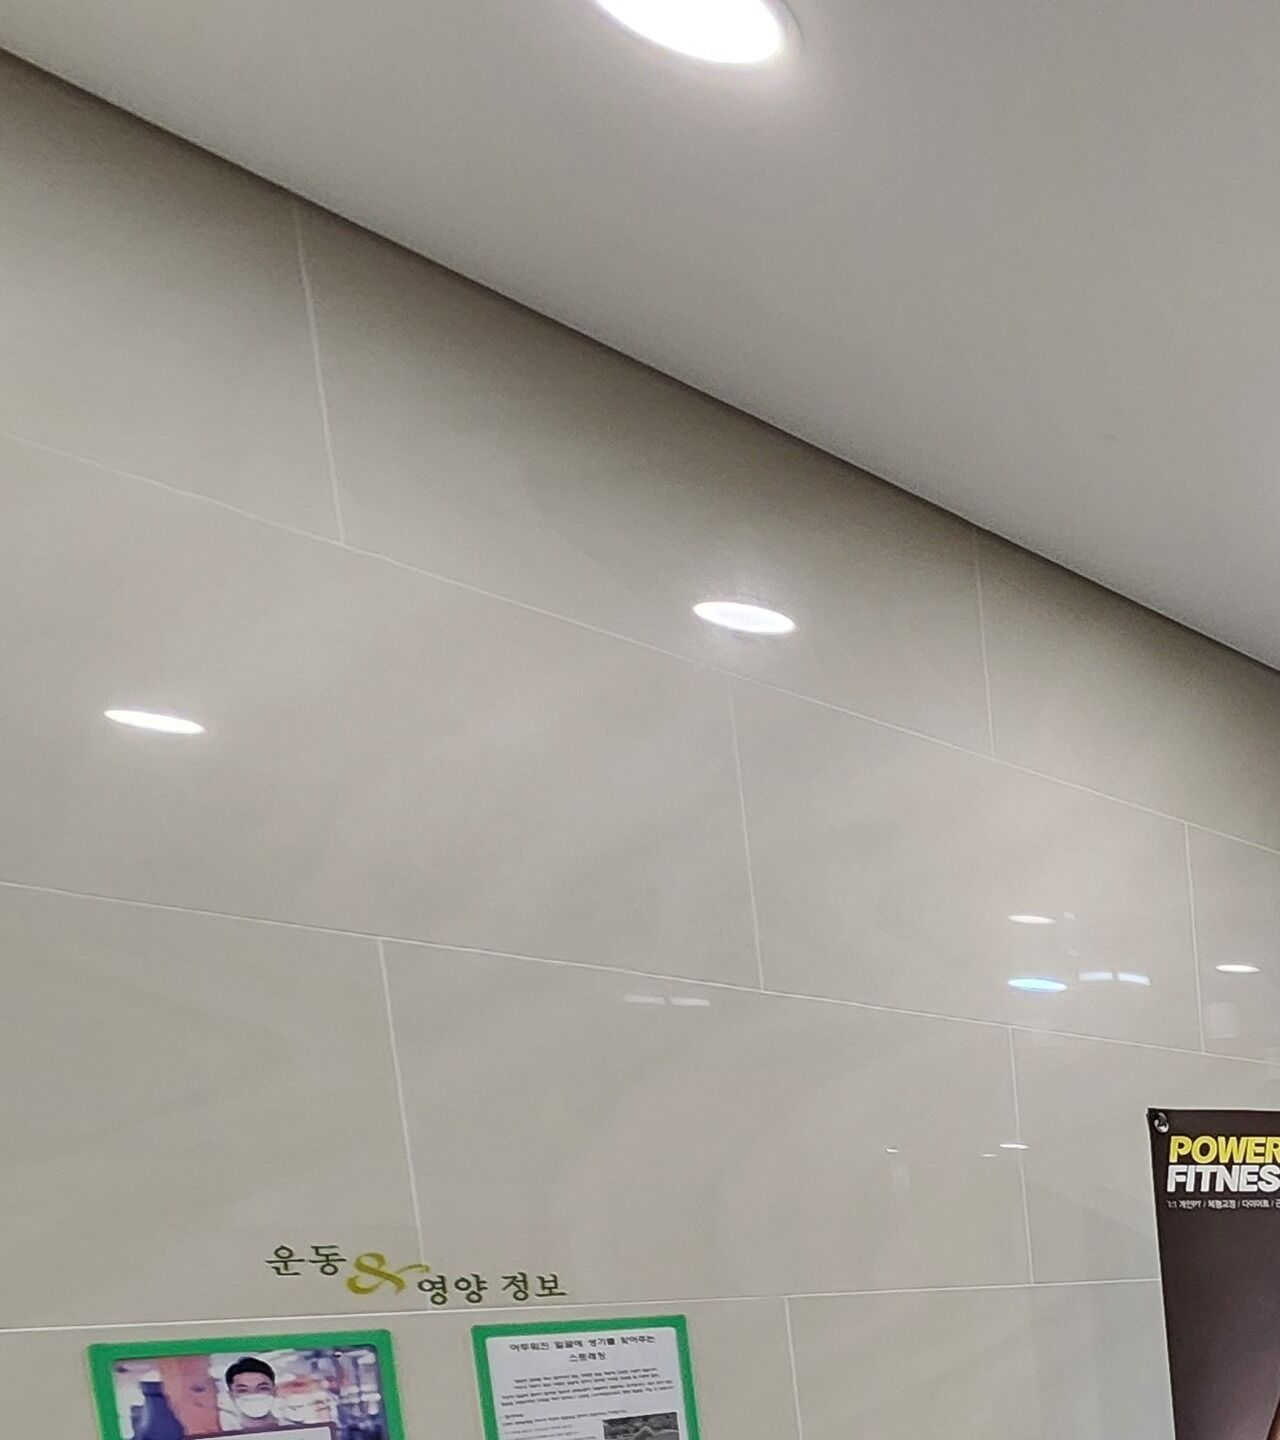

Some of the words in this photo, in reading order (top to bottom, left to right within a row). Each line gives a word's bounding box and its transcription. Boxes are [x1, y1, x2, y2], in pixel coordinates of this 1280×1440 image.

[265, 1245, 347, 1277] 운동
[346, 1252, 431, 1294] &
[417, 1274, 489, 1306] 영양
[502, 1272, 568, 1302] 정보
